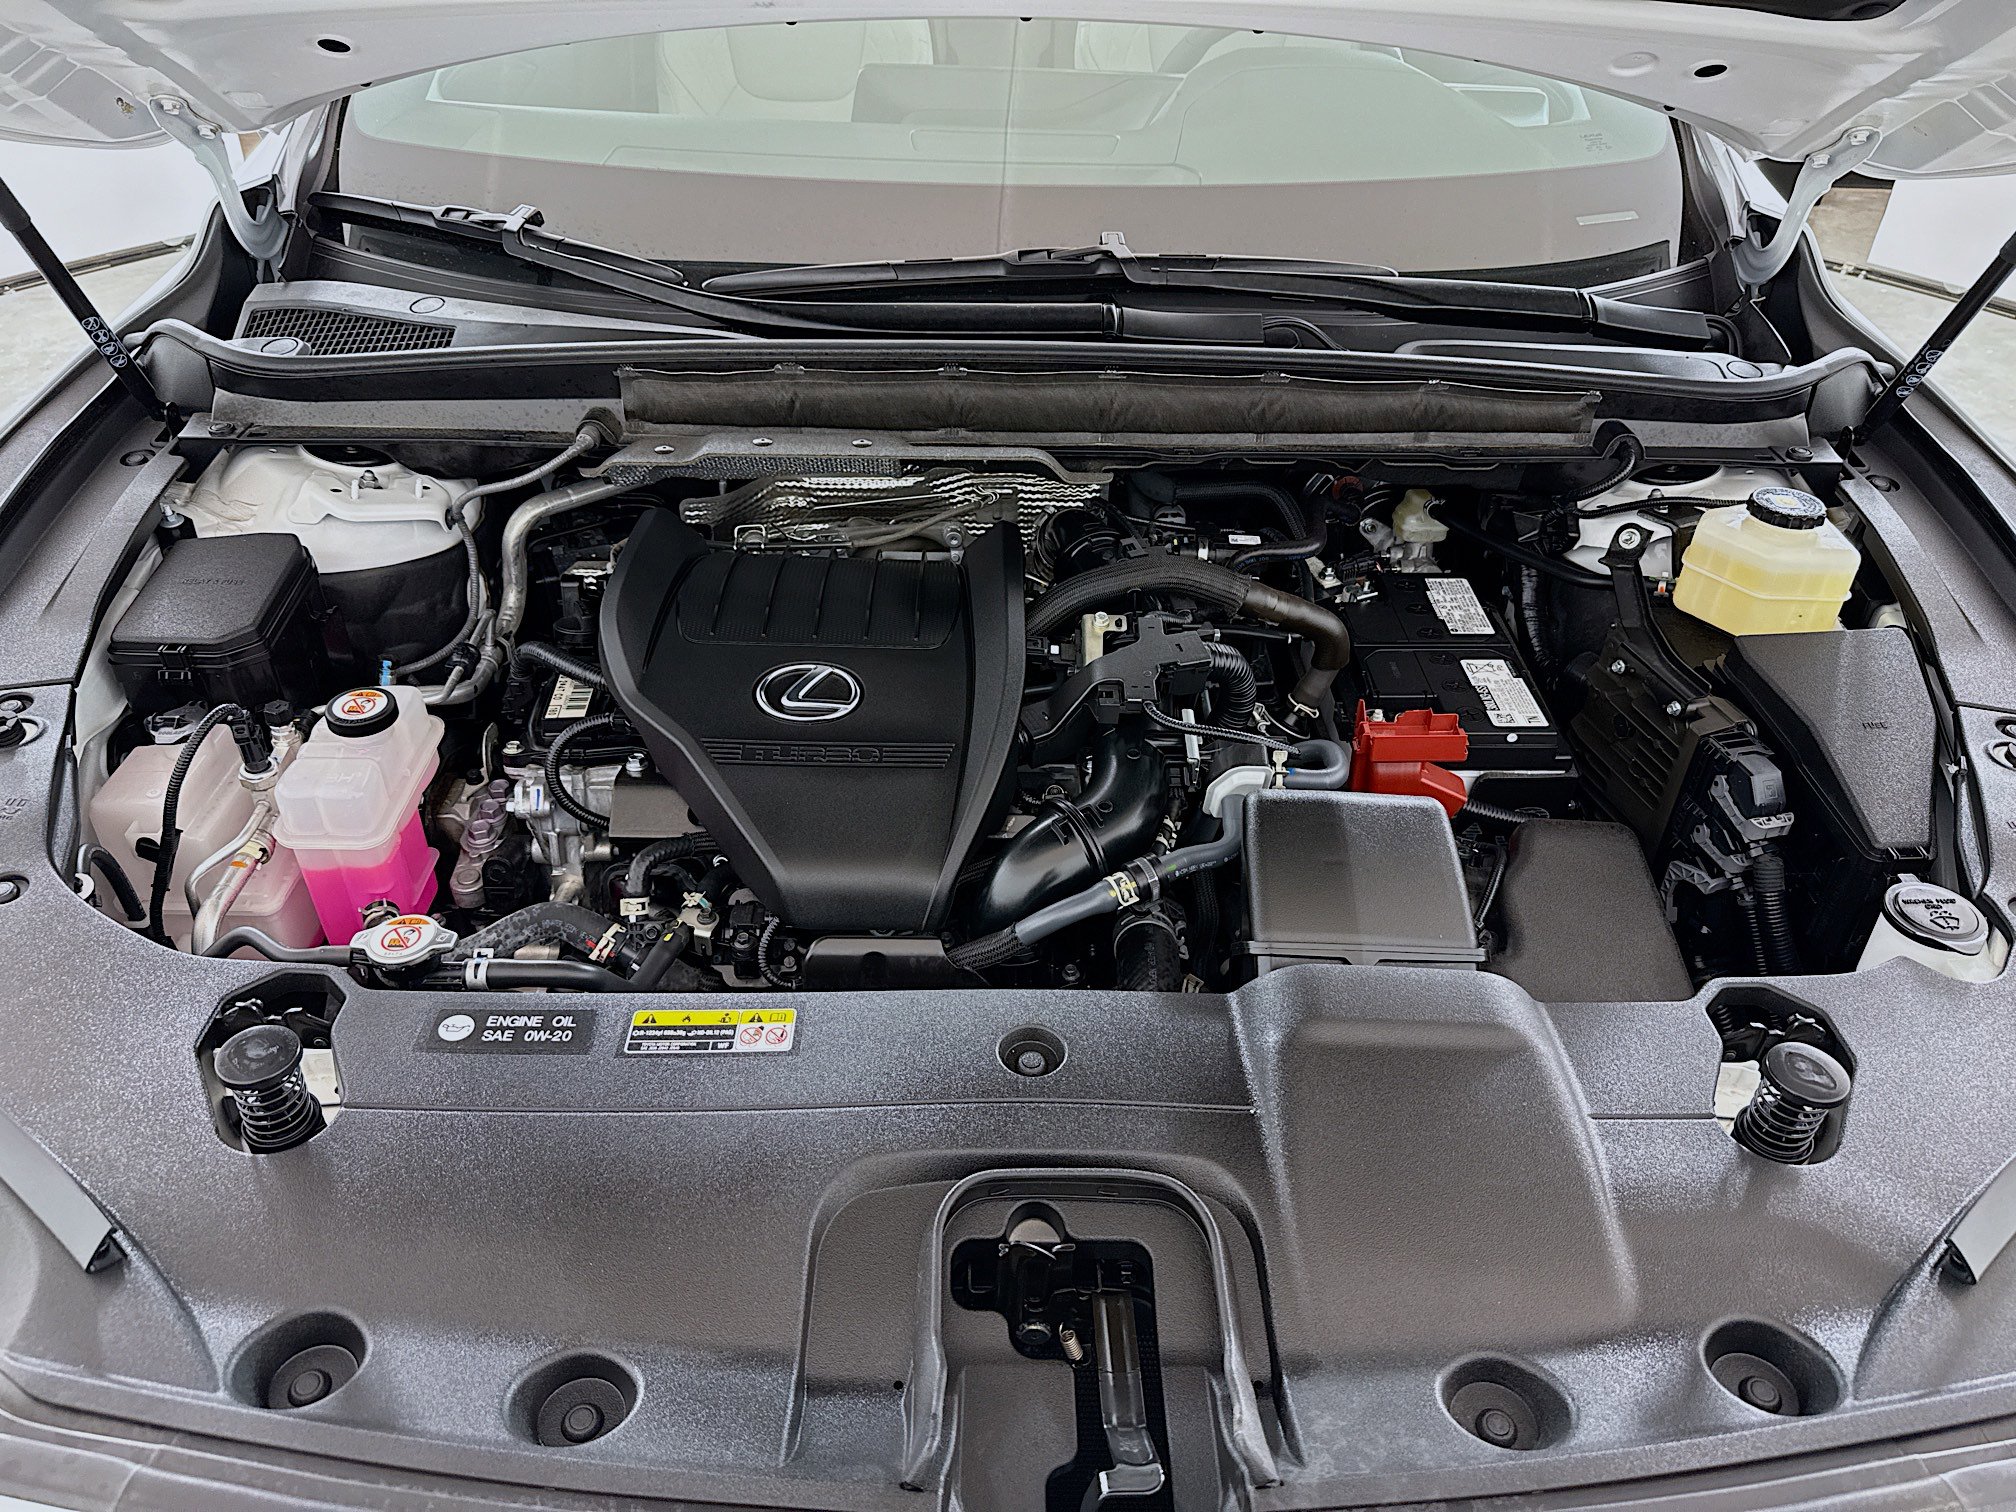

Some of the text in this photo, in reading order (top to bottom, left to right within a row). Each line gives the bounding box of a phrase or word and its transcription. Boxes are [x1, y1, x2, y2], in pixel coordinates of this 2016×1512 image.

[743, 745, 881, 763] TURBO
[486, 1015, 577, 1027] ENGINE OIL
[481, 1030, 573, 1042] SAE 0W-20
